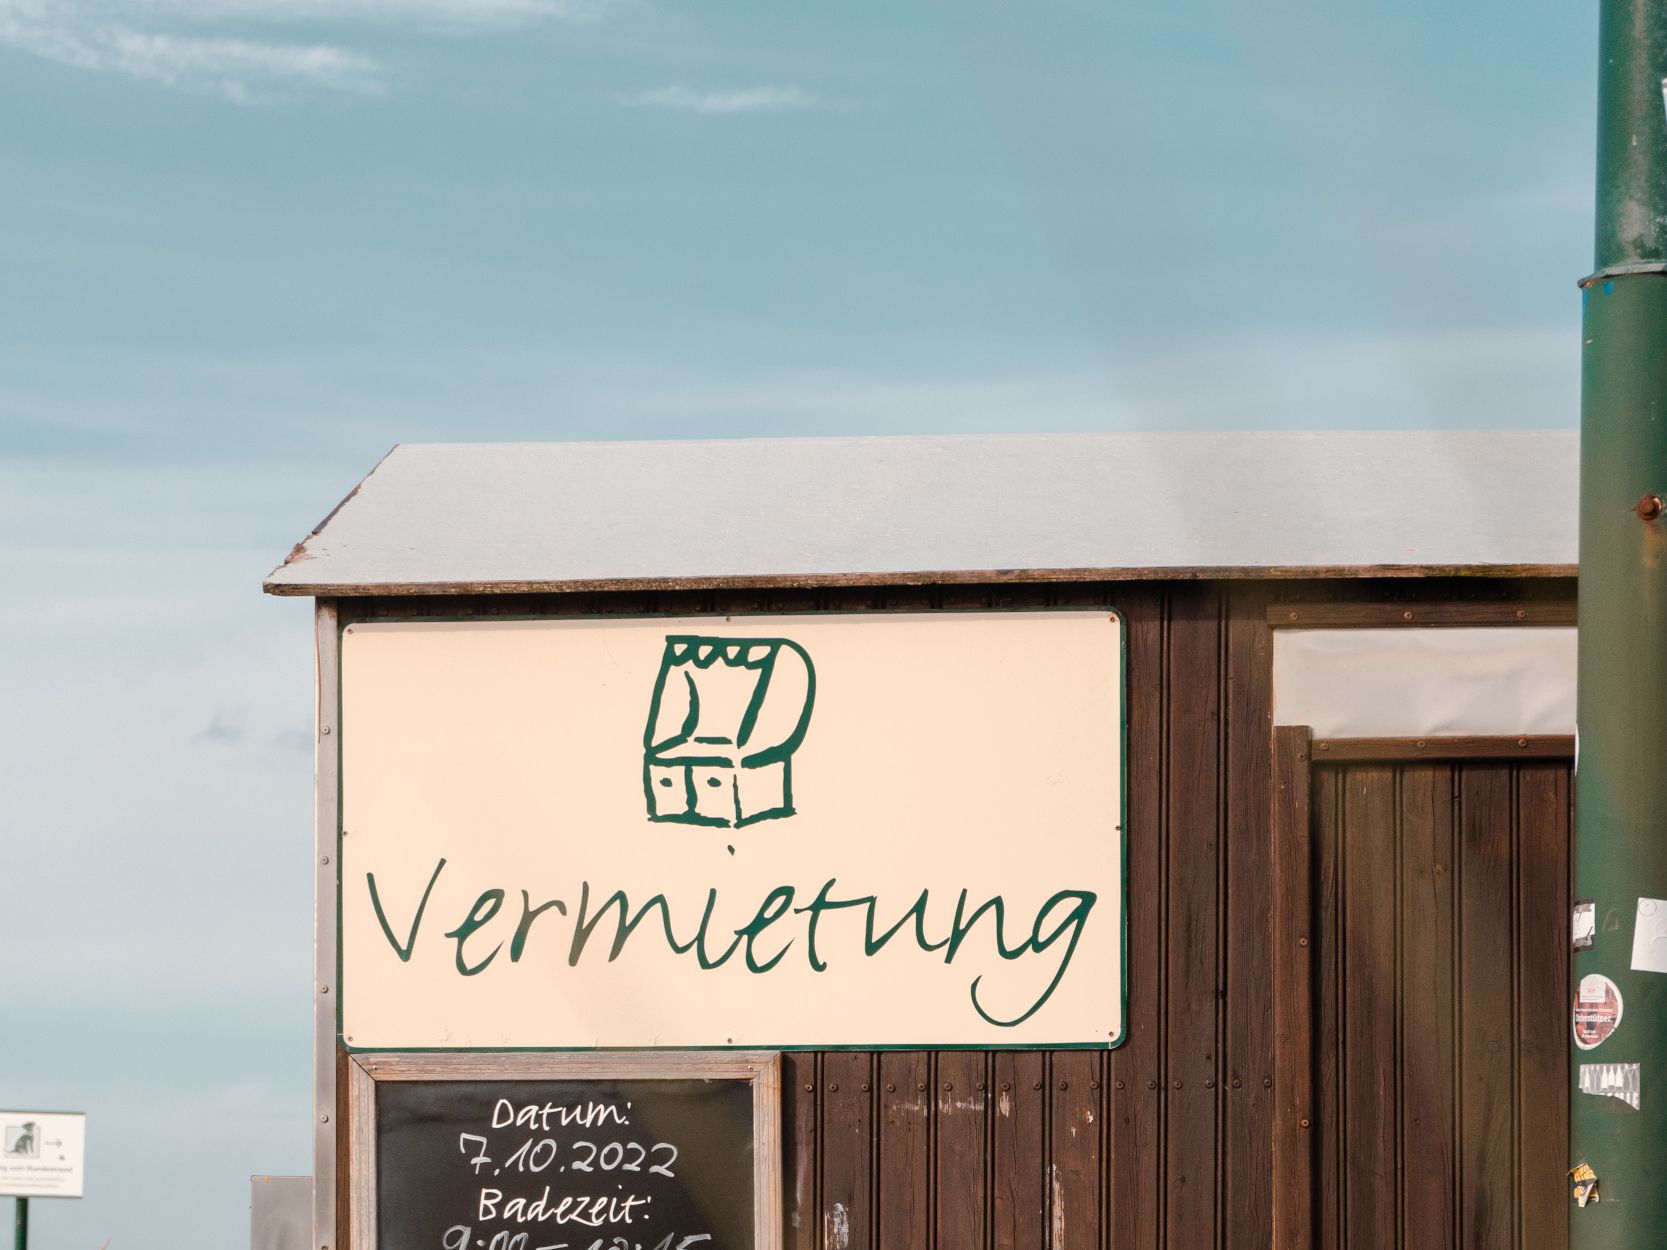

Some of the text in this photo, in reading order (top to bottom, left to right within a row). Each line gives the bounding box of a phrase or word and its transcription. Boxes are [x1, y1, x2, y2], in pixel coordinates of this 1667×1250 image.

[366, 844, 1098, 1027] Vermietung
[491, 1098, 632, 1130] Datum:
[459, 1132, 679, 1178] 7.10.2022
[478, 1184, 652, 1227] Badezeit:
